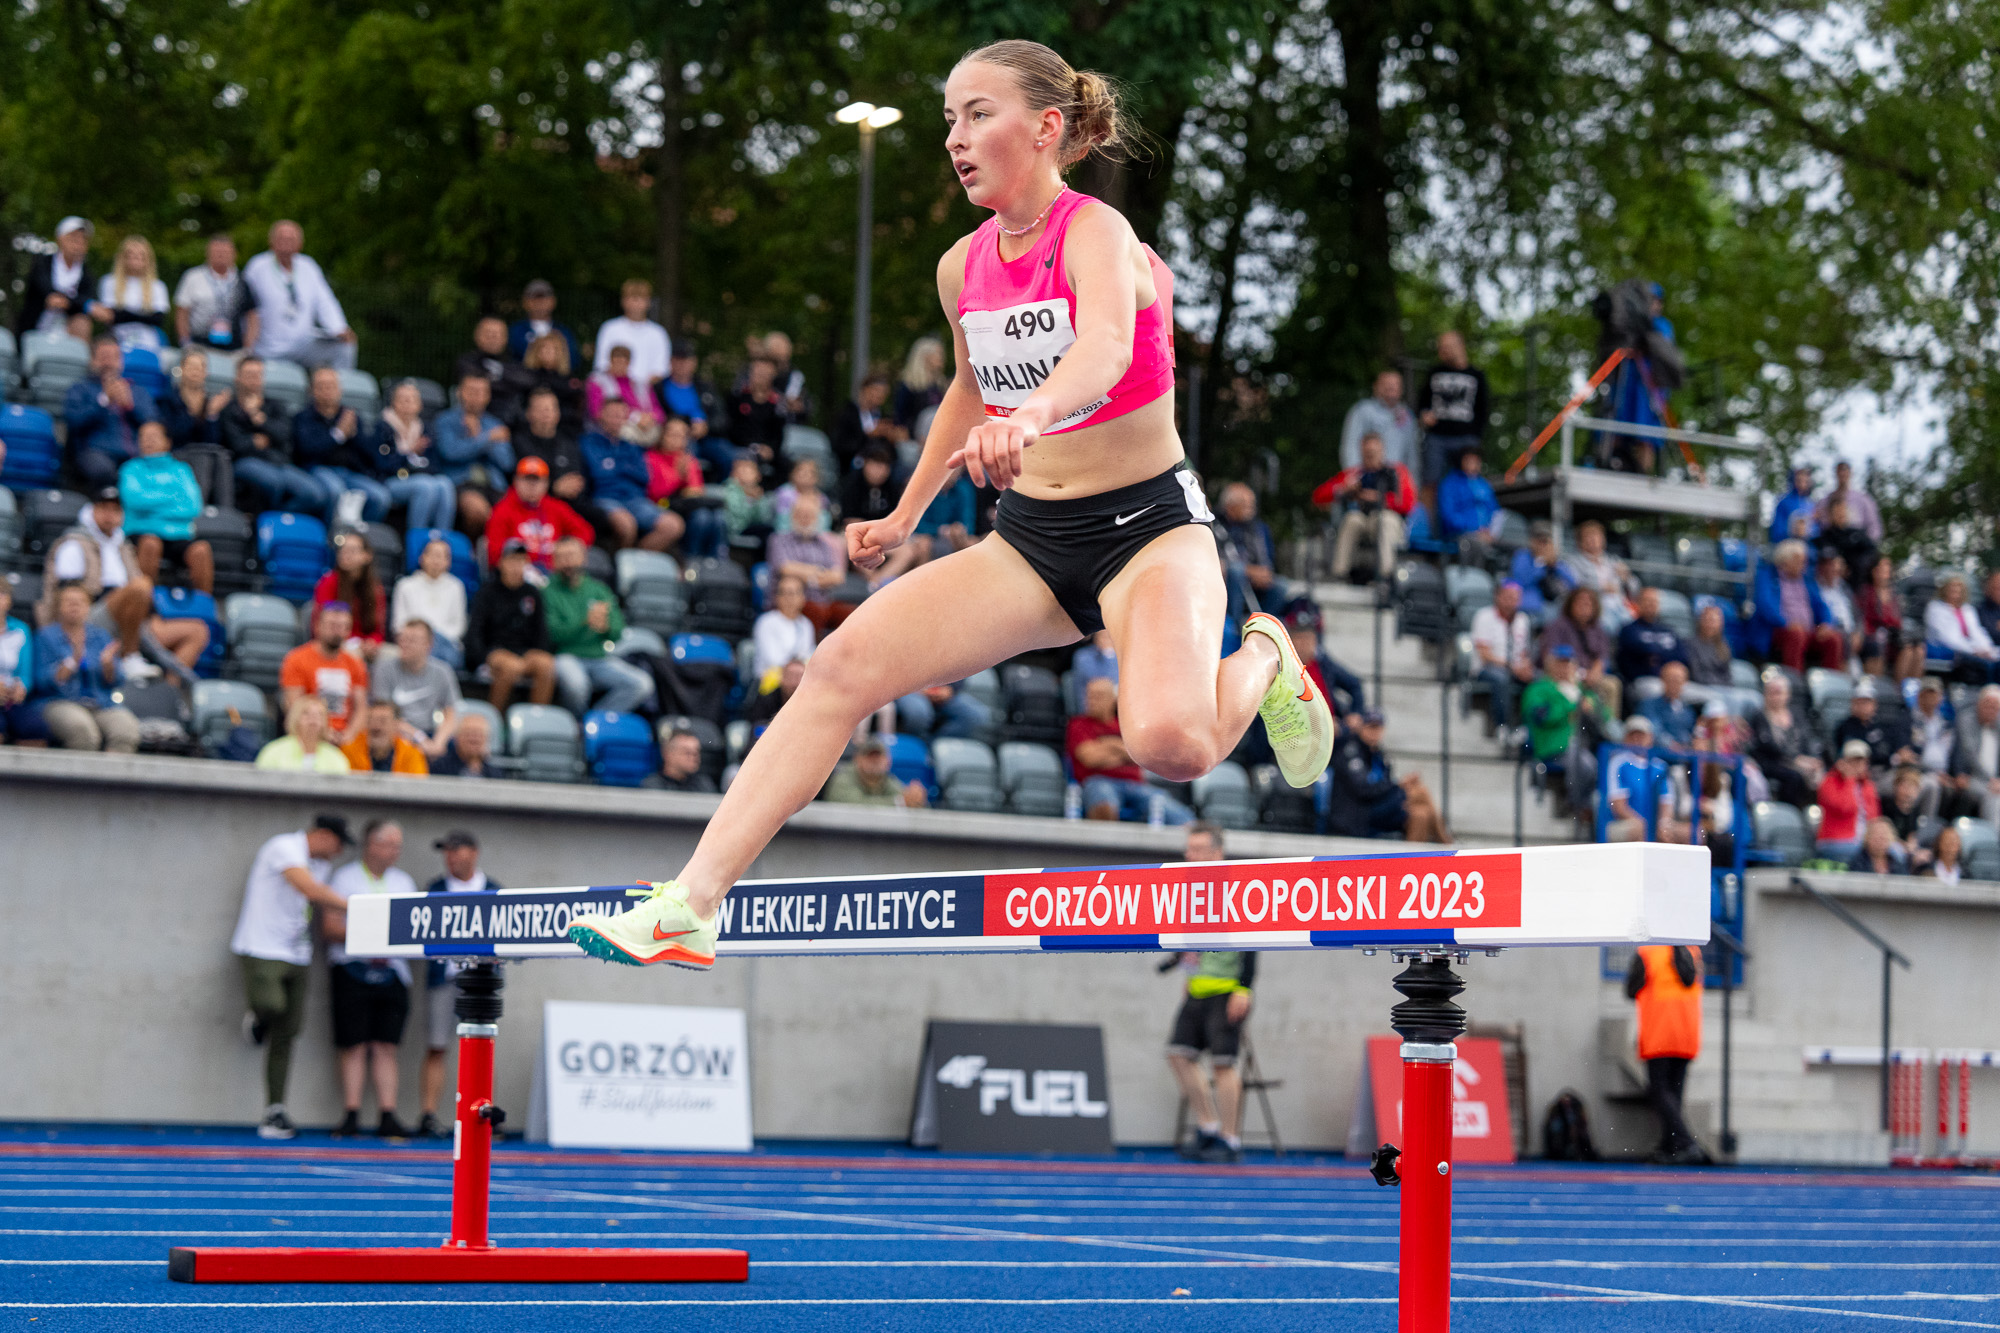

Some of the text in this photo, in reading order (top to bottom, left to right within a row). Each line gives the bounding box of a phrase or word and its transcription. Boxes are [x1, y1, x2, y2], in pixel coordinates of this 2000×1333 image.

[1004, 308, 1055, 340] 490
[1080, 400, 1104, 415] 2023
[410, 906, 436, 939] 99.
[440, 905, 484, 938] PZLA
[715, 897, 735, 934] W
[741, 894, 827, 934] LEKKIEJ
[834, 889, 956, 931] ATLETYCE
[1005, 871, 1484, 928] GORZÓW WIELKOPOLSKI 2023
[559, 1034, 737, 1077] GORZÓW
[979, 1068, 1108, 1117] FUEL
